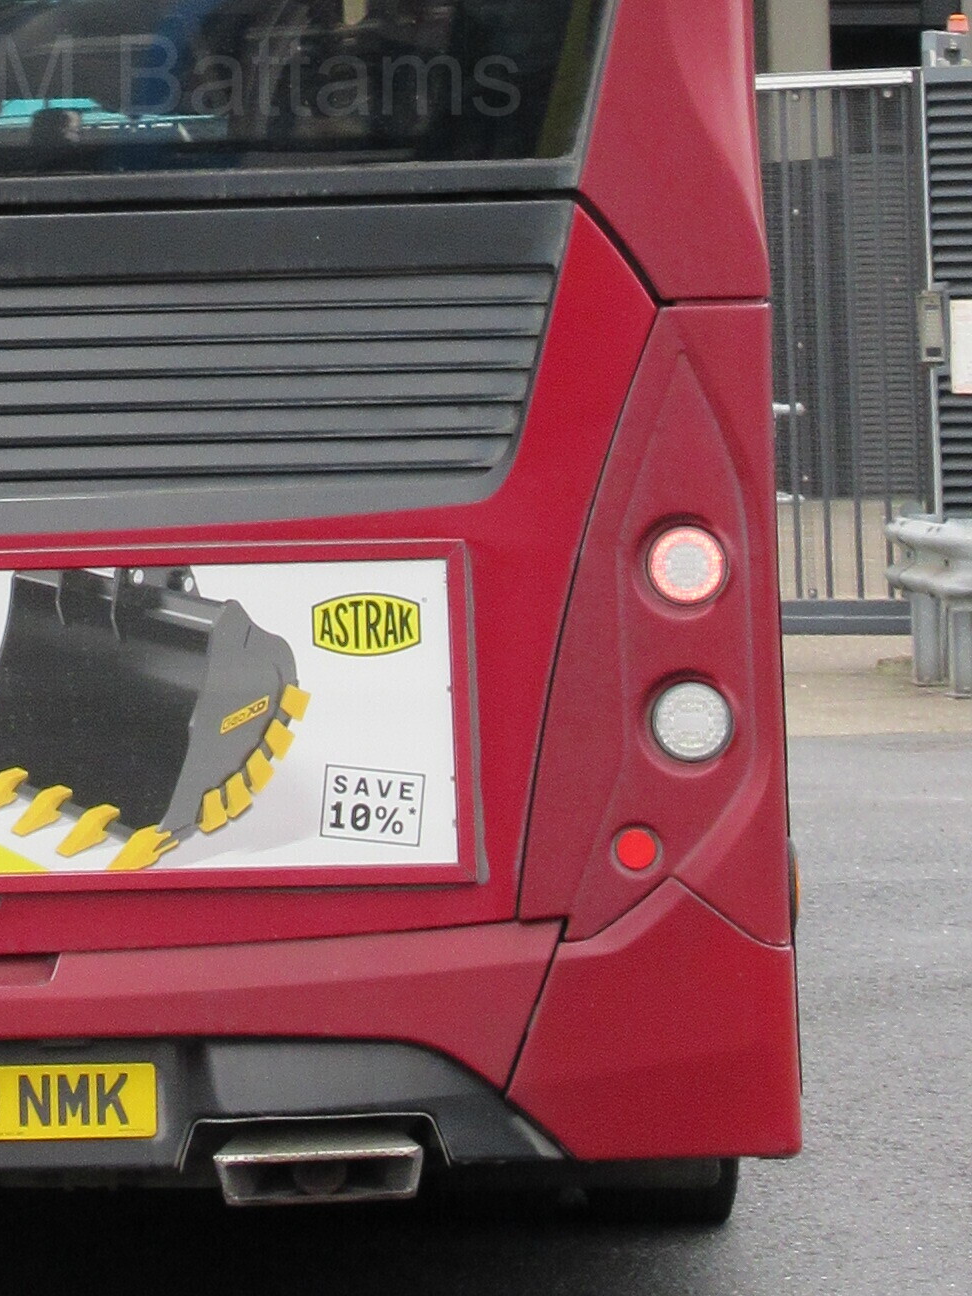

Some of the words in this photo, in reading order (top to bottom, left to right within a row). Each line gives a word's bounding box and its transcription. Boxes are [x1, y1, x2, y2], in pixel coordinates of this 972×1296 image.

[319, 600, 414, 650] ASTRAK
[333, 774, 416, 802] SAVE
[17, 1073, 129, 1127] NMK
